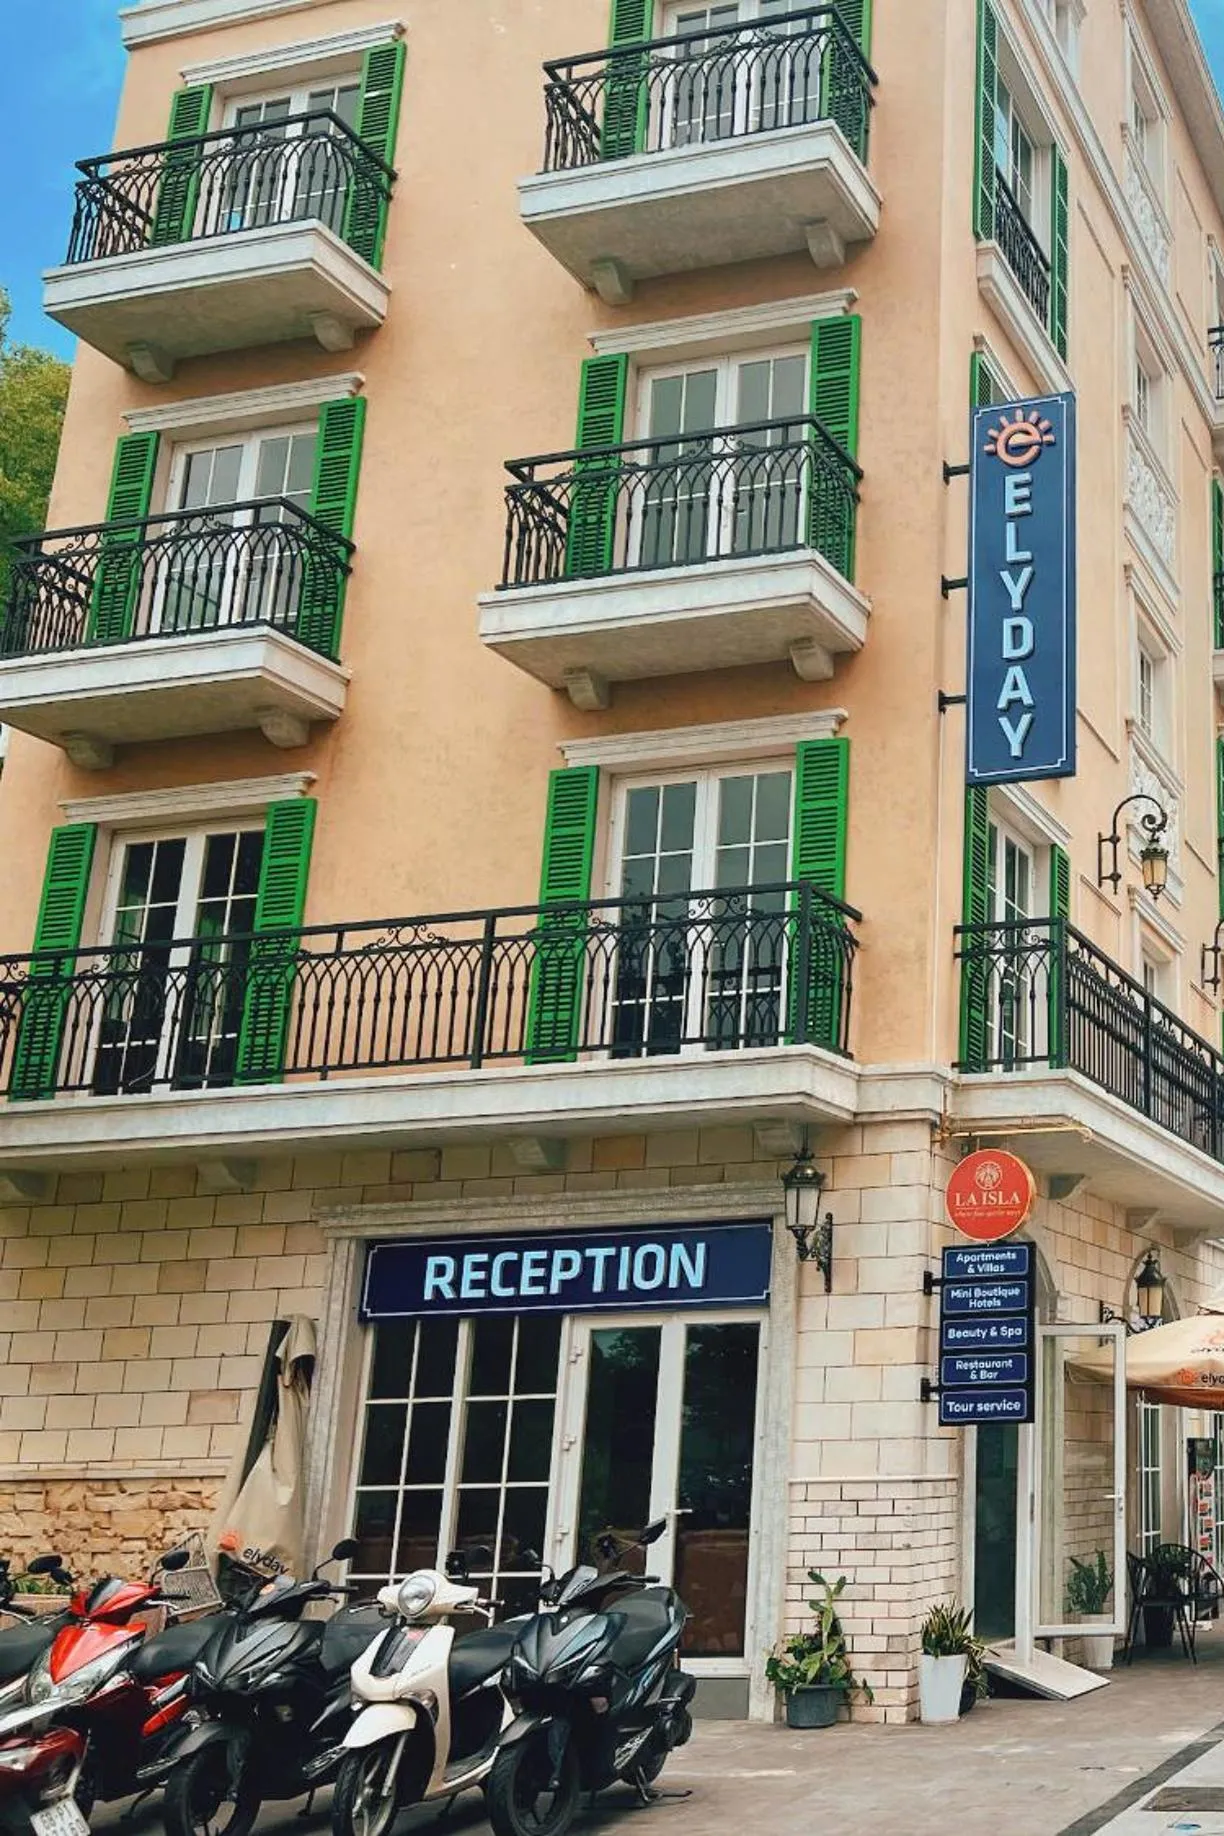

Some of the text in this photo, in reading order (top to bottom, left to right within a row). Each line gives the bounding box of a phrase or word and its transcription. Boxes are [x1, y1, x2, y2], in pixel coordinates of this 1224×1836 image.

[997, 472, 1035, 759] ELYDAY
[955, 1190, 1020, 1206] LA ISLA
[956, 1251, 1017, 1264] Apartments
[423, 1242, 706, 1300] RECEPTION
[967, 1263, 1005, 1274] & Villas
[950, 1286, 1021, 1299] Mini Boutique
[968, 1297, 1001, 1308] Hotels
[947, 1325, 1022, 1339] Beauty & Spa
[955, 1359, 1013, 1370] Restaurant
[970, 1370, 999, 1380] & Bar
[946, 1398, 1021, 1412] Tour service
